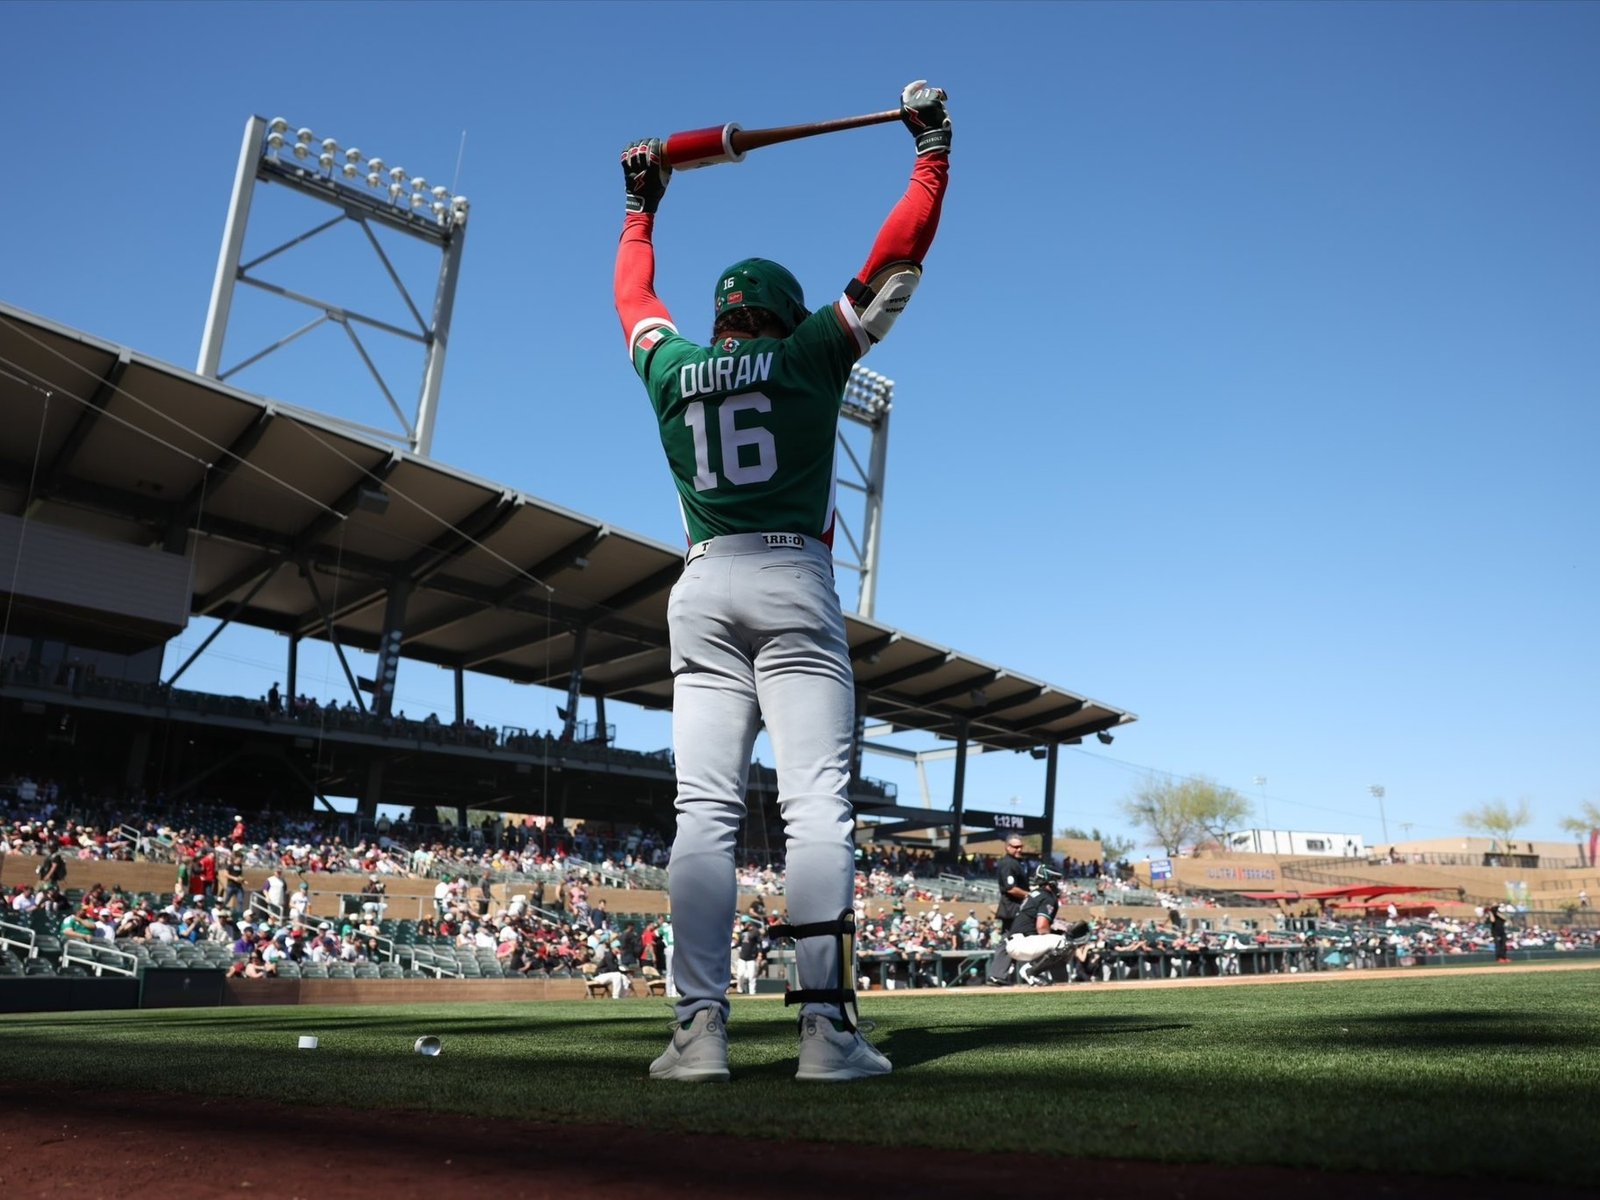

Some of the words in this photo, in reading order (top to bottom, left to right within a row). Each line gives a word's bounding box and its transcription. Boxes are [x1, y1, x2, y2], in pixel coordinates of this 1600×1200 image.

[723, 277, 735, 290] 16
[680, 352, 774, 398] DURAN
[684, 391, 778, 492] 16
[994, 814, 1010, 828] 1:12
[1011, 816, 1024, 829] PM
